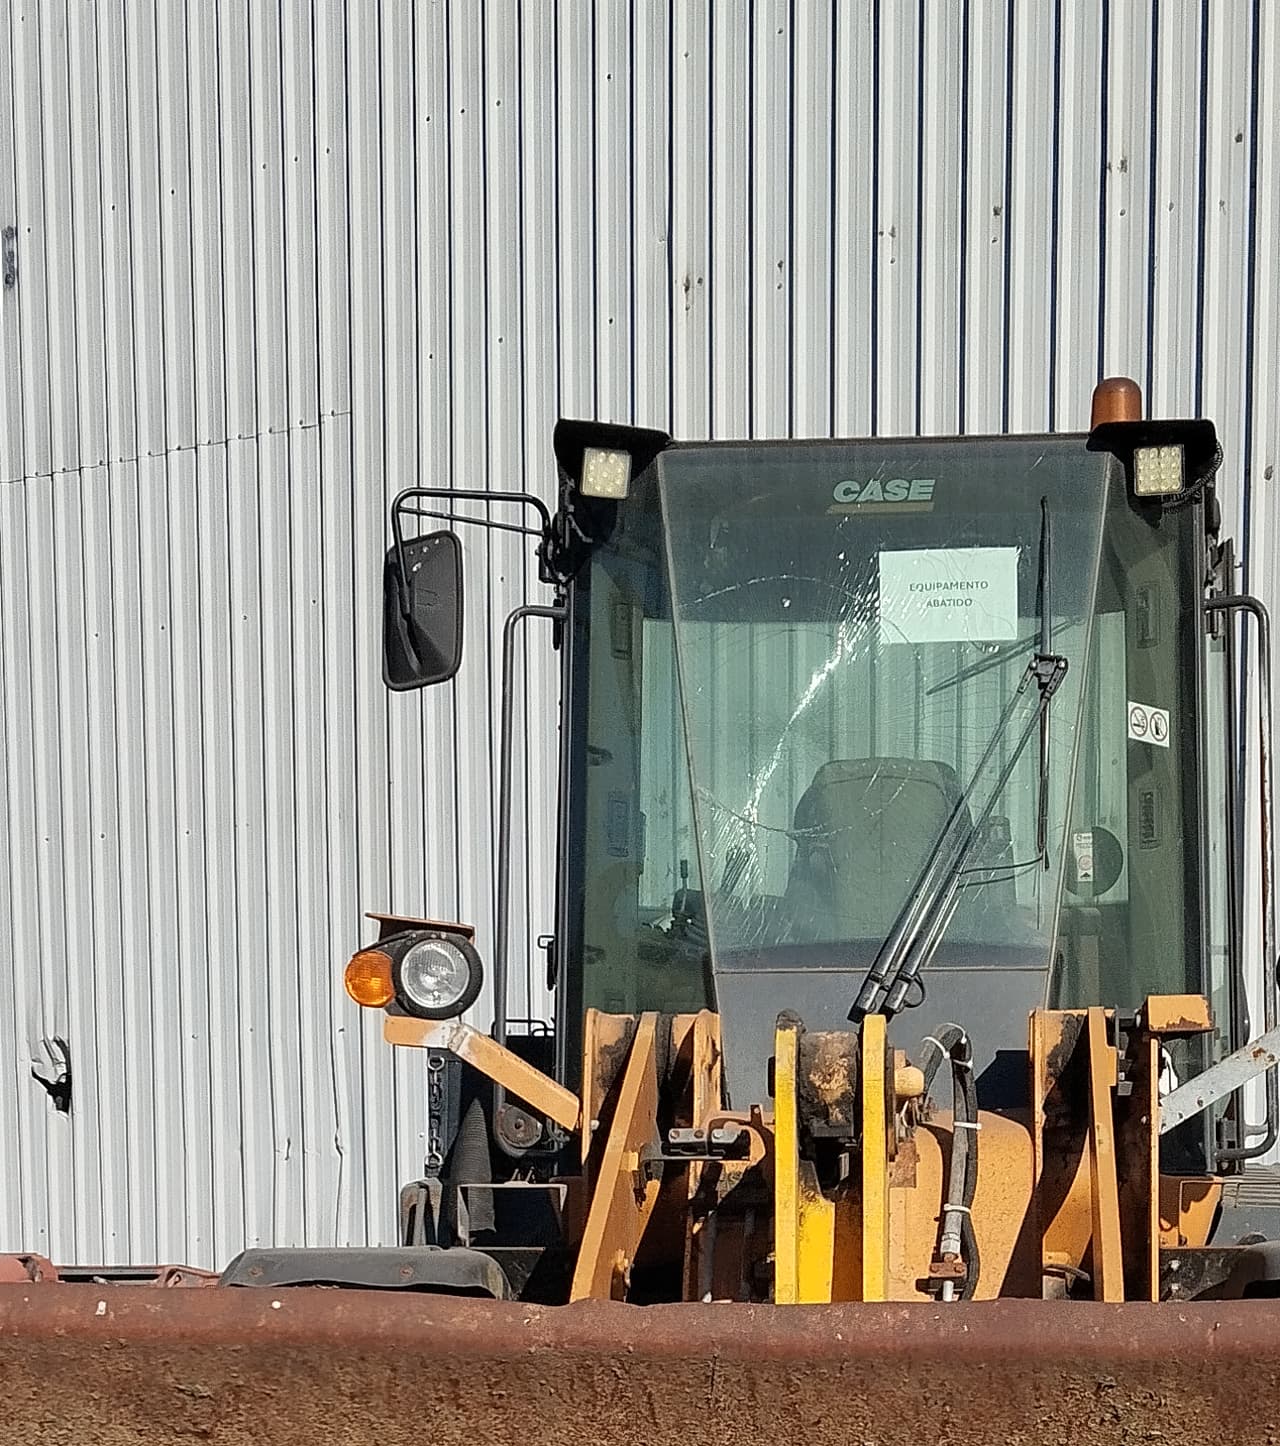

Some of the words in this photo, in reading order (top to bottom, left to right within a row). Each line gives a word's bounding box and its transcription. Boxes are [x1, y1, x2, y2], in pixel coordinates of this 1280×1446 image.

[833, 479, 936, 503] CASE
[908, 580, 990, 593] EQUIPAMENTO
[925, 598, 974, 608] ABATIDO
